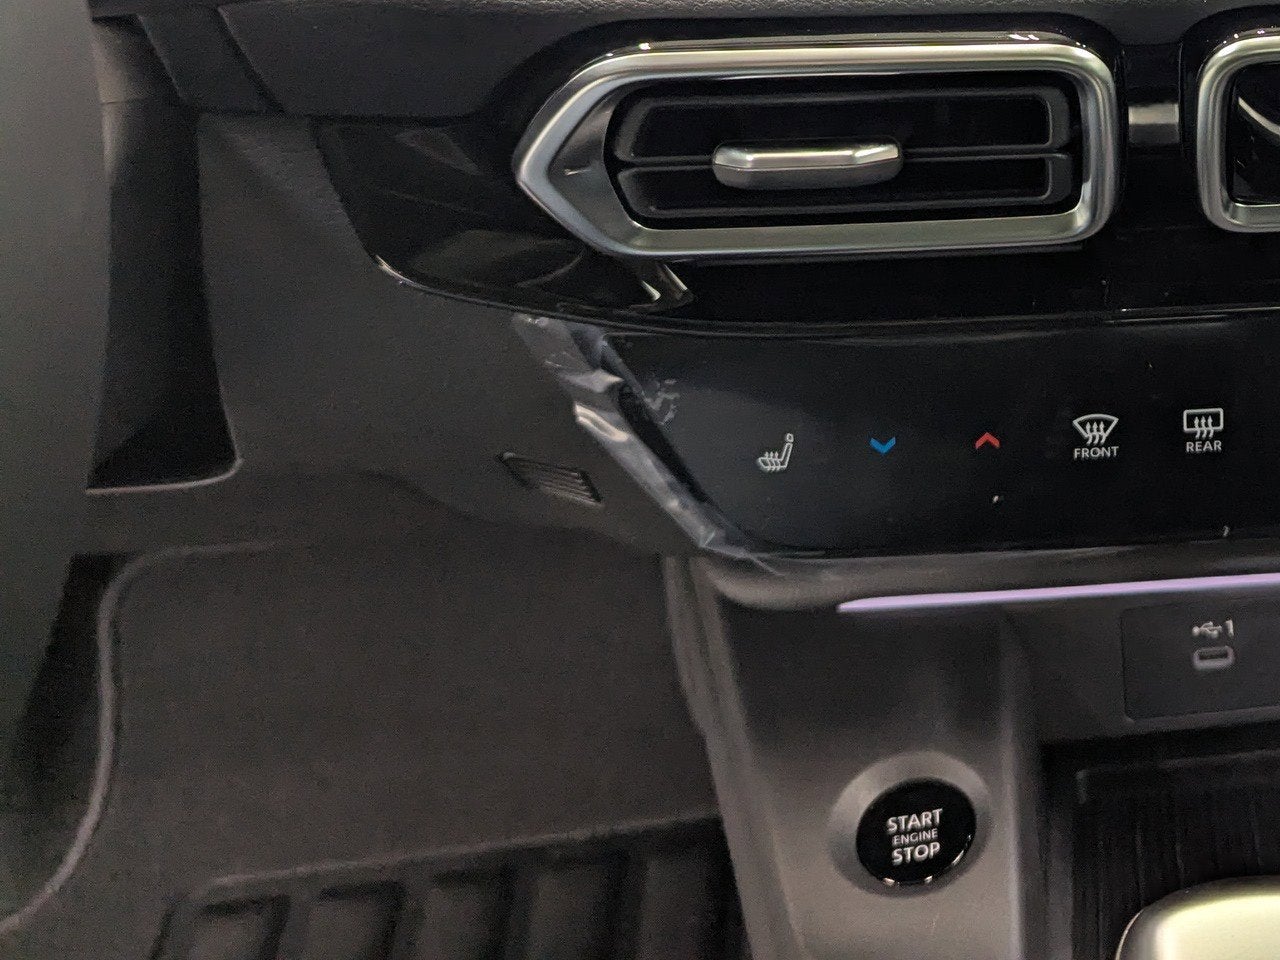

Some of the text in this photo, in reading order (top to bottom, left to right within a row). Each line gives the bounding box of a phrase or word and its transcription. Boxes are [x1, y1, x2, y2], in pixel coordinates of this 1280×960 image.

[1074, 446, 1118, 458] FRONT
[1186, 440, 1221, 452] REAR
[886, 808, 943, 832] START
[893, 829, 937, 845] ENGINE
[893, 842, 940, 863] STOP
